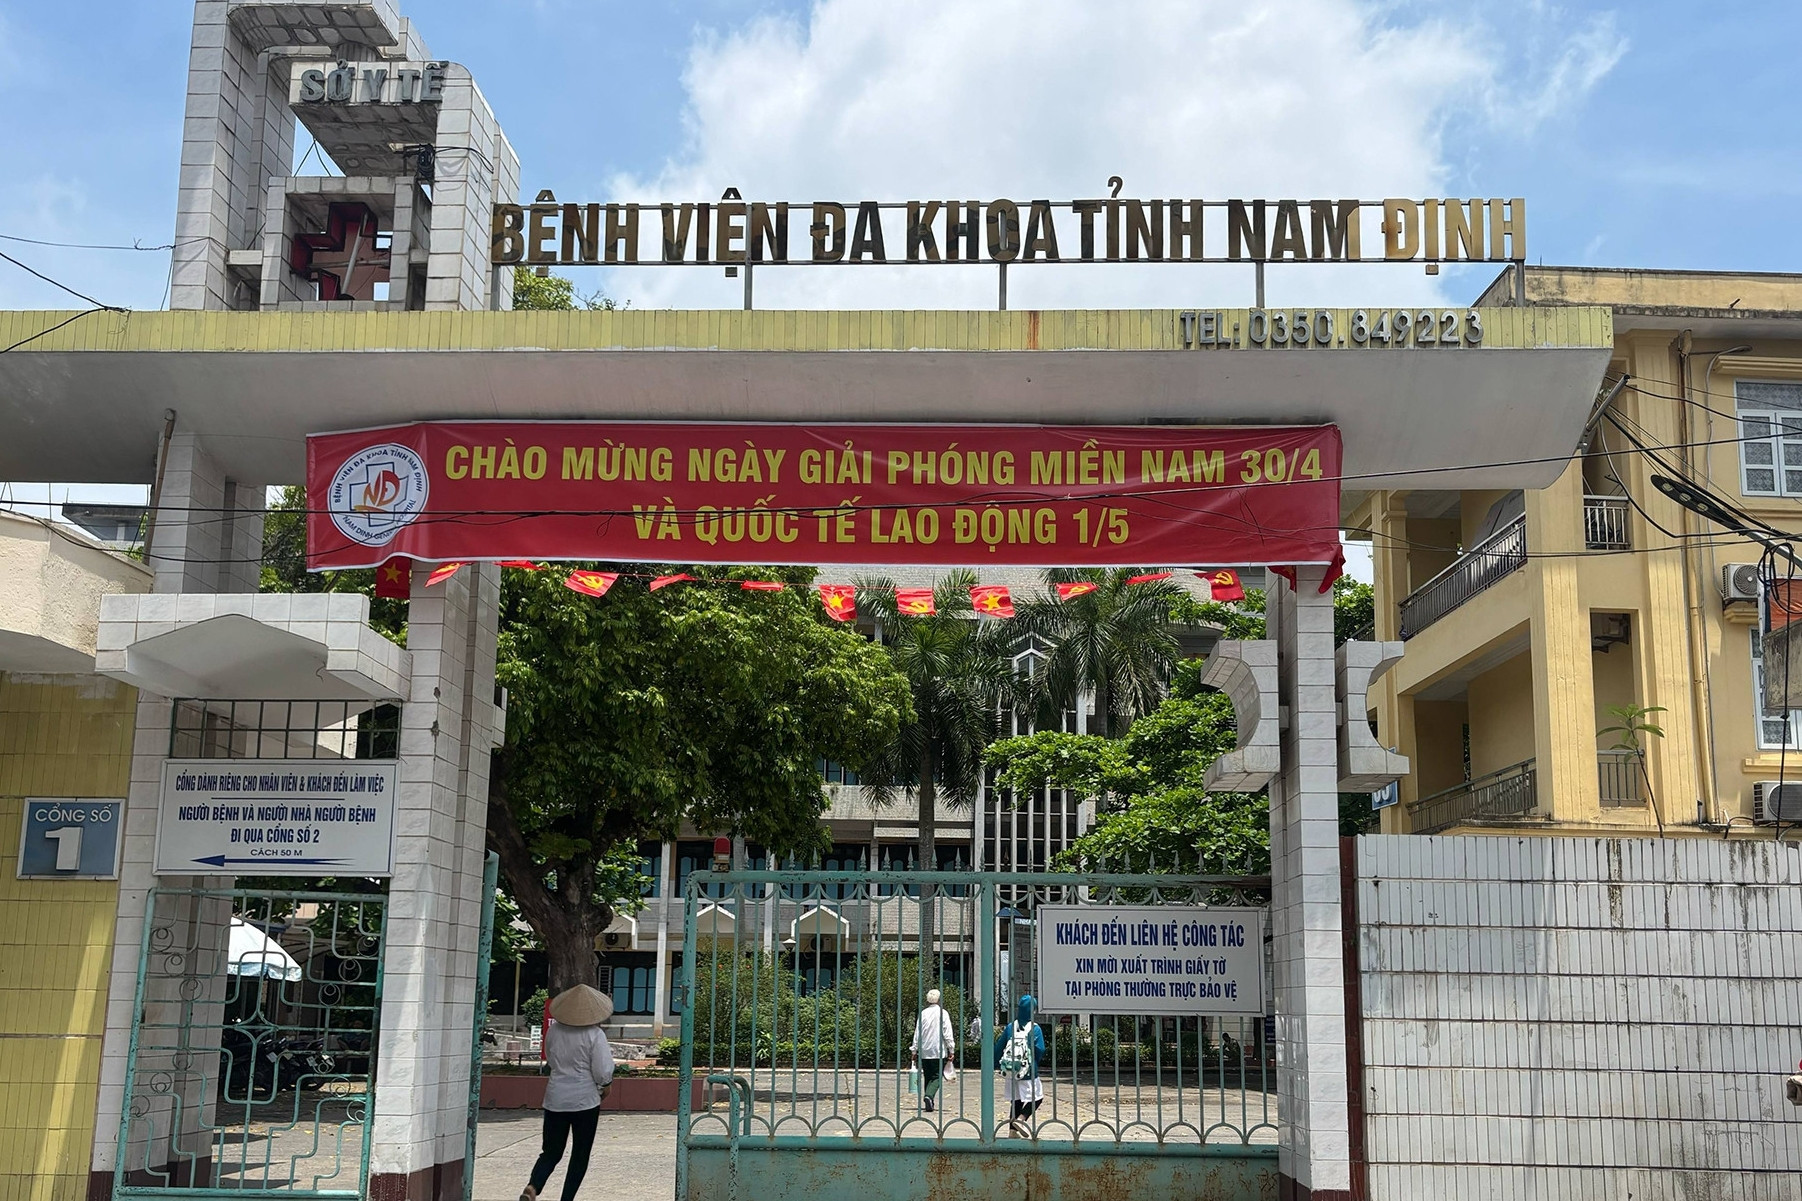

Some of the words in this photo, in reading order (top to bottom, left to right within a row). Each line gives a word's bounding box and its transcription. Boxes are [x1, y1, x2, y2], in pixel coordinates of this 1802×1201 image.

[301, 59, 355, 102] SỞ
[362, 69, 388, 102] Y
[397, 61, 449, 103] TẾ
[491, 189, 639, 278] BỆNH
[660, 187, 788, 278] VIỆN
[810, 201, 887, 263] ĐA
[906, 198, 1060, 262] KHOA
[1072, 176, 1204, 261] TỈNH
[1228, 199, 1360, 261] NAM
[1381, 198, 1526, 275] ĐỊNH
[1180, 310, 1240, 344] TEL:
[446, 437, 548, 480] CHÀO
[561, 438, 673, 482] MỪNG
[688, 440, 786, 483] NGÀY
[799, 440, 872, 484] GIẢI
[887, 442, 1015, 485] PHÓNG
[1030, 438, 1126, 485] MIỀN
[1141, 450, 1226, 484] NAM
[1240, 448, 1323, 486] 30/4
[342, 514, 358, 531] NAM
[632, 496, 682, 541] VÀ
[695, 494, 799, 546] QUỐC
[813, 496, 863, 544] TẾ
[871, 508, 940, 544] LAO
[952, 500, 1057, 552] ĐỘNG
[1073, 507, 1130, 548] 1/5
[197, 772, 218, 791] DÀNH
[219, 772, 241, 791] RIÊNG
[242, 775, 258, 791] CHO
[258, 772, 280, 792] NHÂN
[281, 772, 298, 792] VIÊN
[299, 776, 306, 792] &
[306, 772, 332, 792] KHÁCH
[333, 770, 349, 792] ĐẾN
[349, 773, 367, 792] LÀM
[367, 773, 384, 796] VIỆC
[35, 802, 86, 822] CỔNG
[90, 803, 112, 822] SỐ
[179, 803, 210, 821] NGƯỜI
[212, 803, 240, 824] BỆNH
[242, 804, 254, 821] VÀ
[257, 803, 288, 822] NGƯỜI
[290, 804, 312, 822] NHÀ
[314, 804, 346, 822] NGƯỜI
[348, 804, 377, 825] BỆNH
[231, 828, 241, 843] ĐI
[244, 828, 264, 845] QUA
[297, 824, 311, 843] SỐ
[313, 829, 320, 843] 2
[45, 826, 84, 870] 1
[250, 847, 279, 856] CÁCH
[1056, 918, 1098, 945] KHÁCH
[1101, 915, 1127, 946] ĐẾN
[1131, 919, 1158, 946] LIÊN
[1162, 919, 1178, 951] HỆ
[1182, 919, 1217, 947] CÔNG
[1220, 920, 1244, 947] TÁC
[1075, 958, 1094, 974] XIN
[1097, 954, 1118, 974] MỜI
[1120, 953, 1148, 974] XUẤT
[1151, 956, 1182, 975] TRÌNH
[1185, 954, 1210, 975] GIẤY
[1212, 956, 1227, 975] TỜ
[1065, 980, 1081, 1000] TẠI
[1085, 977, 1121, 997] PHÒNG
[1124, 977, 1166, 998] THƯỜNG
[1168, 980, 1196, 1001] TRỰC
[1199, 976, 1221, 998] BẢO
[1223, 979, 1237, 1002] VỆ
